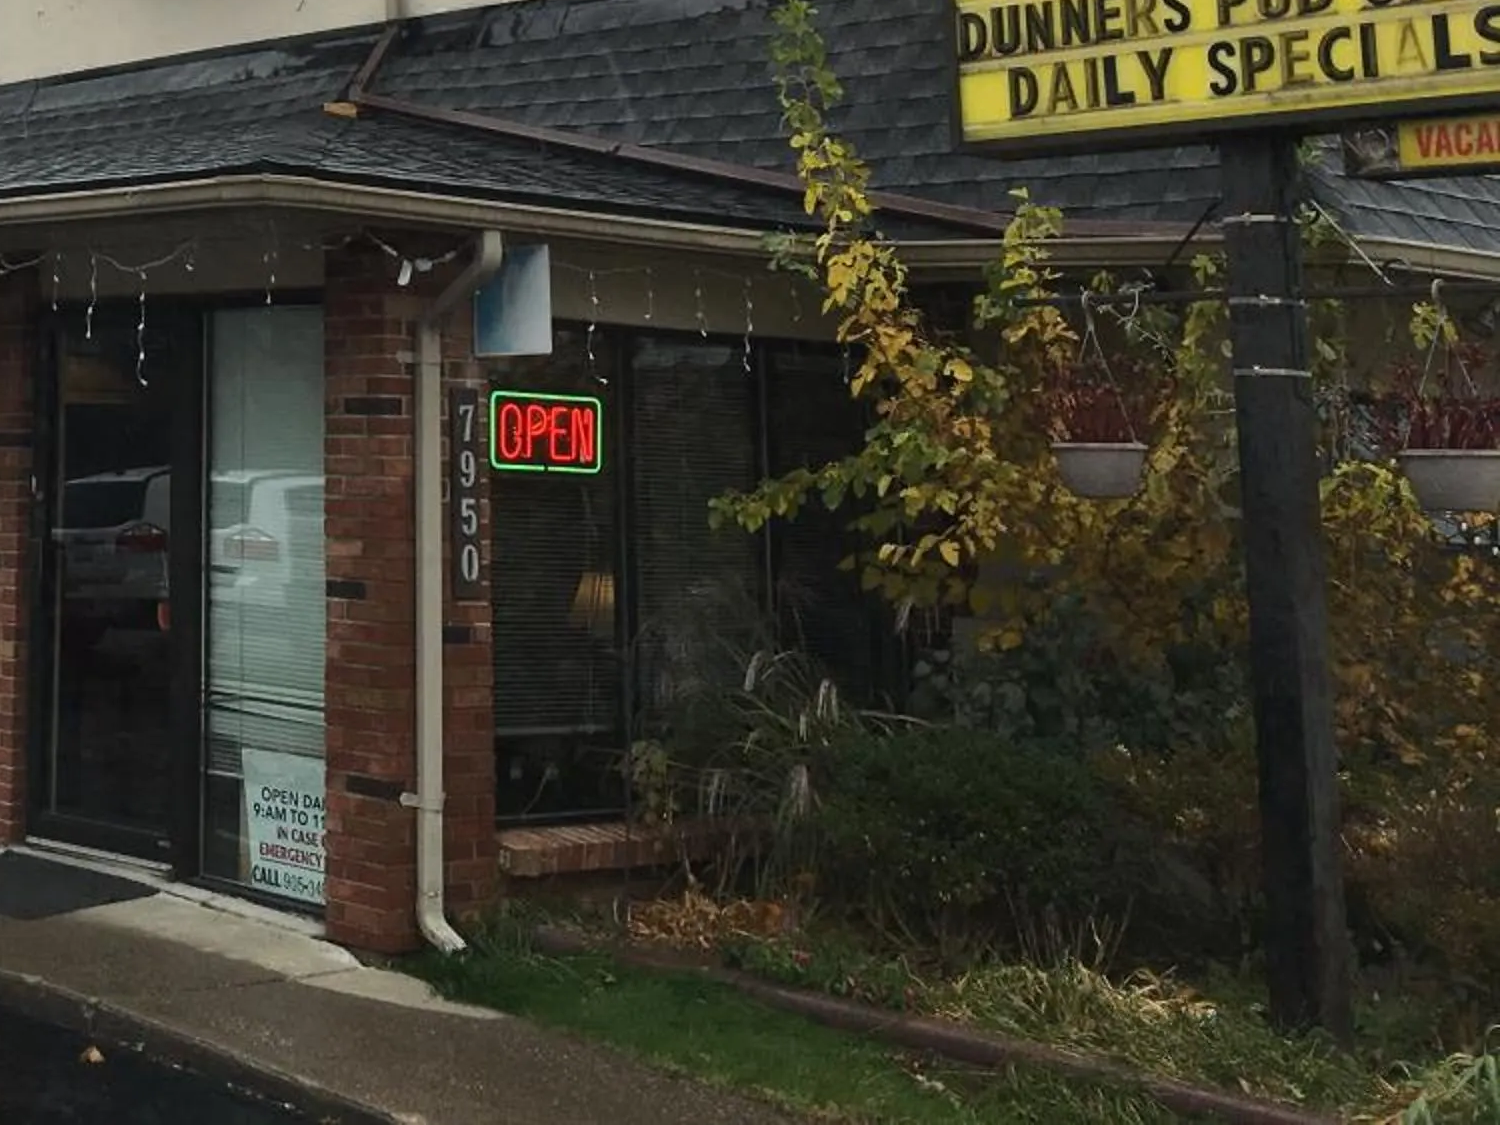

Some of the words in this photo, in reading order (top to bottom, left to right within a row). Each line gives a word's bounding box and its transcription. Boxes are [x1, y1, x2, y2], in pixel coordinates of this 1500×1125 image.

[1007, 47, 1173, 118] DAILY
[1207, 5, 1500, 98] SPECIALS
[1415, 121, 1500, 158] VACA
[500, 402, 594, 463] OPEN
[459, 404, 479, 582] 7950
[261, 786, 299, 807] OPEN
[253, 802, 286, 823] 9:AM
[290, 809, 308, 826] TO
[277, 826, 288, 840] IN
[291, 829, 318, 847] CASE
[260, 842, 322, 868] EMERGENCY
[253, 865, 281, 888] CALL
